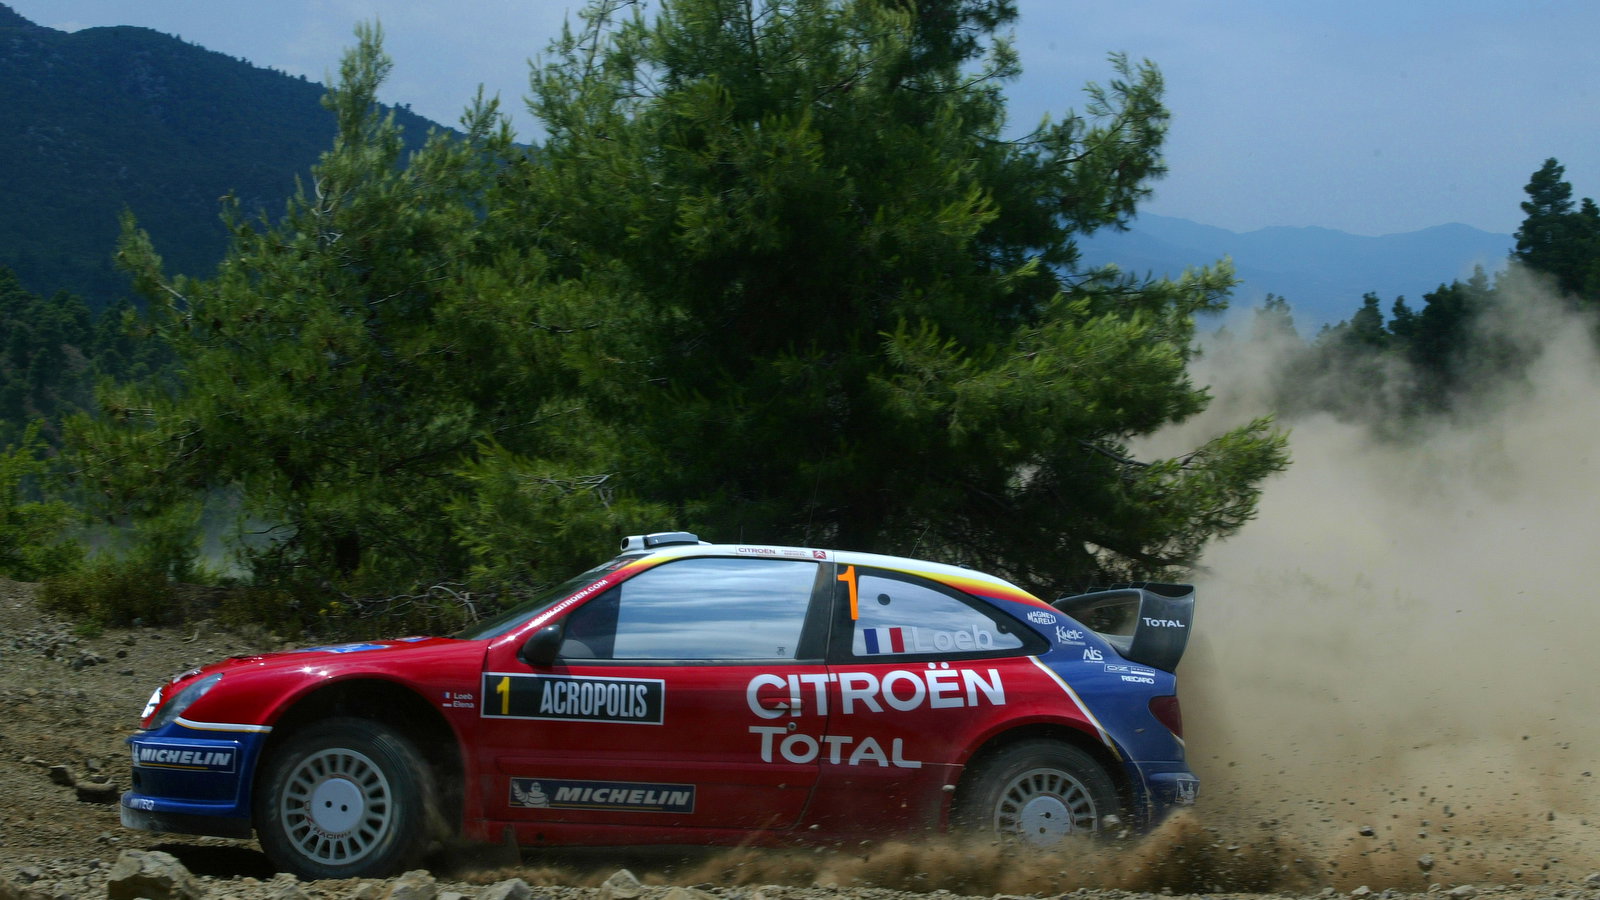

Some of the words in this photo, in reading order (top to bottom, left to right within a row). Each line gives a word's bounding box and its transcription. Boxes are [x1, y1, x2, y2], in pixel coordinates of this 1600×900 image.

[837, 565, 859, 621] 1
[1142, 617, 1186, 628] TOTAL
[911, 624, 993, 652] Loeb
[746, 662, 1006, 719] CITROËN
[1121, 675, 1155, 685] RECARO
[453, 692, 473, 700] Loeb
[496, 676, 511, 715] 1
[540, 680, 648, 719] ACROPOLIS
[140, 748, 232, 766] MICHELIN
[748, 726, 922, 769] TOTAL
[554, 786, 691, 806] MICHELIN
